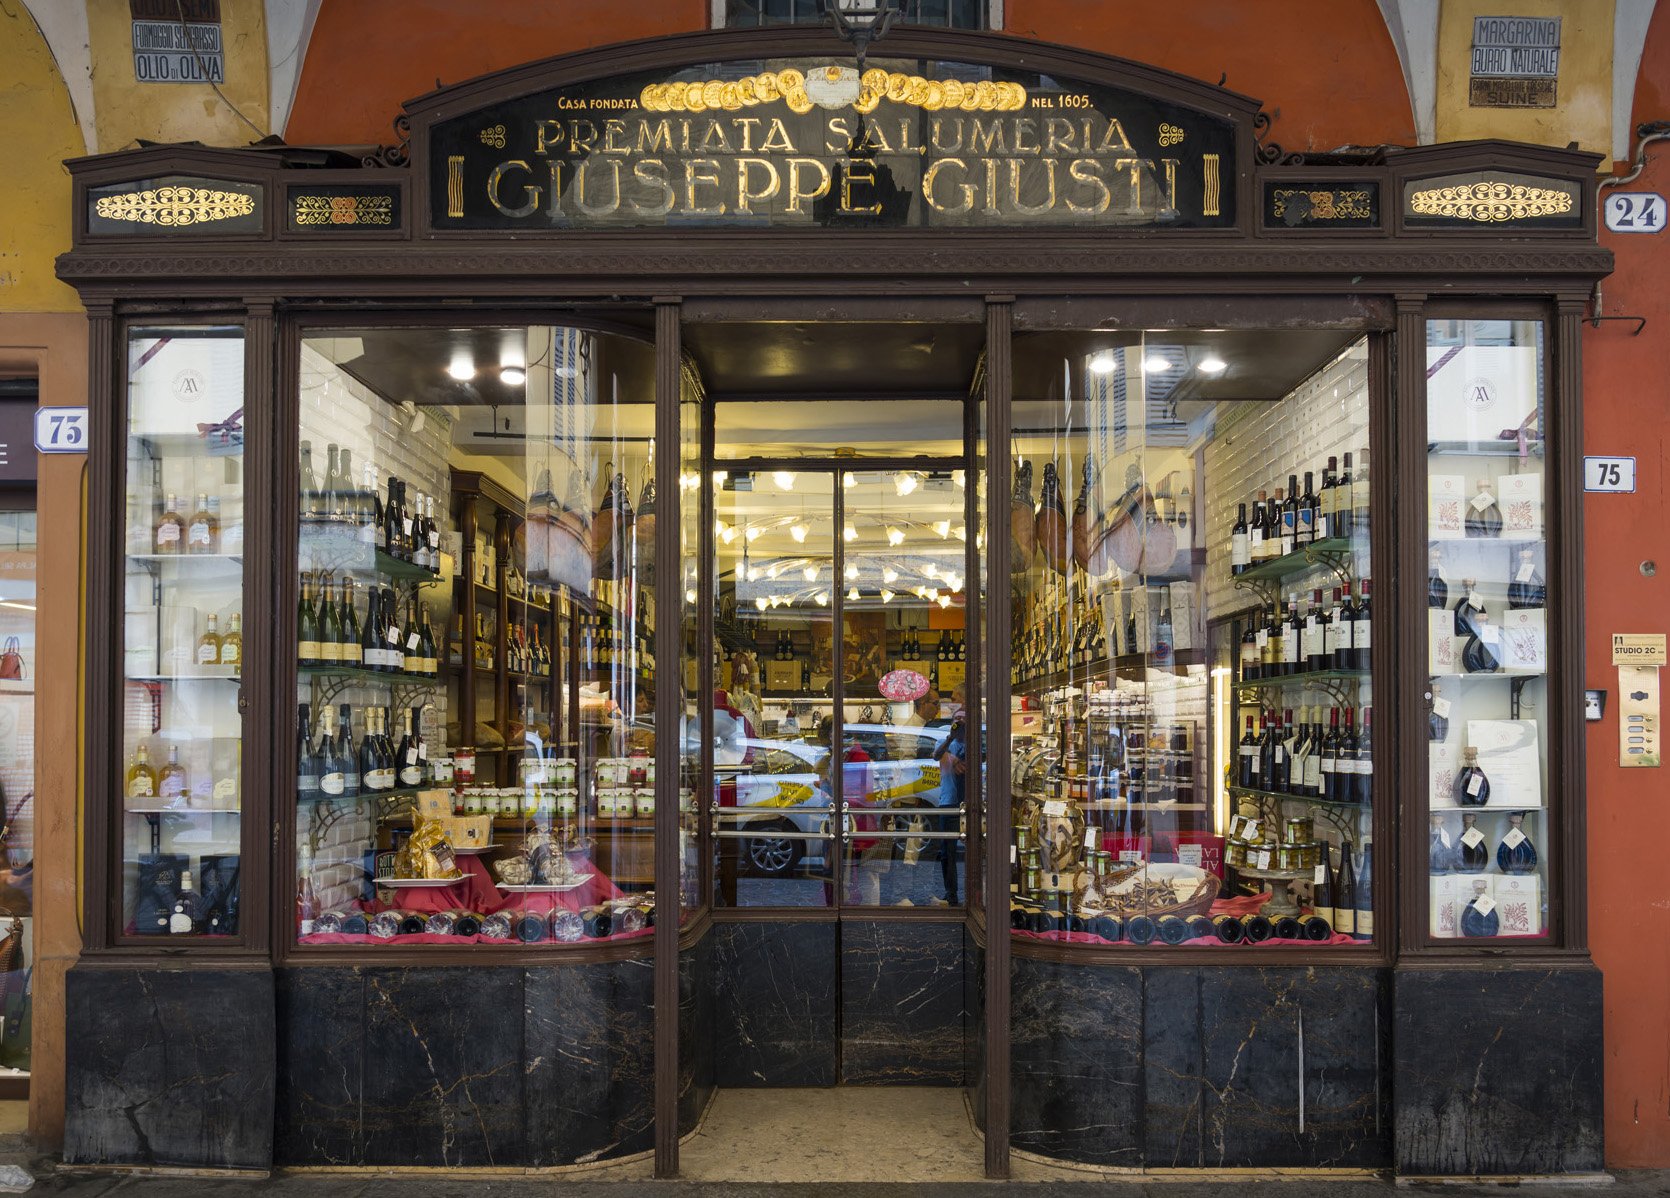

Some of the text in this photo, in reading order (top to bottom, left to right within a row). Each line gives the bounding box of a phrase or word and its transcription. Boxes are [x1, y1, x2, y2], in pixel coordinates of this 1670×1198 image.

[1478, 20, 1556, 45] MARGARINA
[137, 55, 221, 80] OLIO DI OLIVA
[1474, 49, 1557, 74] BURRO NATURALE
[558, 96, 639, 110] CASA FONDATA
[1032, 95, 1094, 109] NEL 1605.
[1487, 92, 1538, 104] SUINE
[534, 117, 1138, 156] PREMIATA SALUMERIA
[487, 157, 1181, 217] GIUSEPPE GIUSTI
[1615, 197, 1657, 227] 24
[1598, 463, 1621, 486] 75
